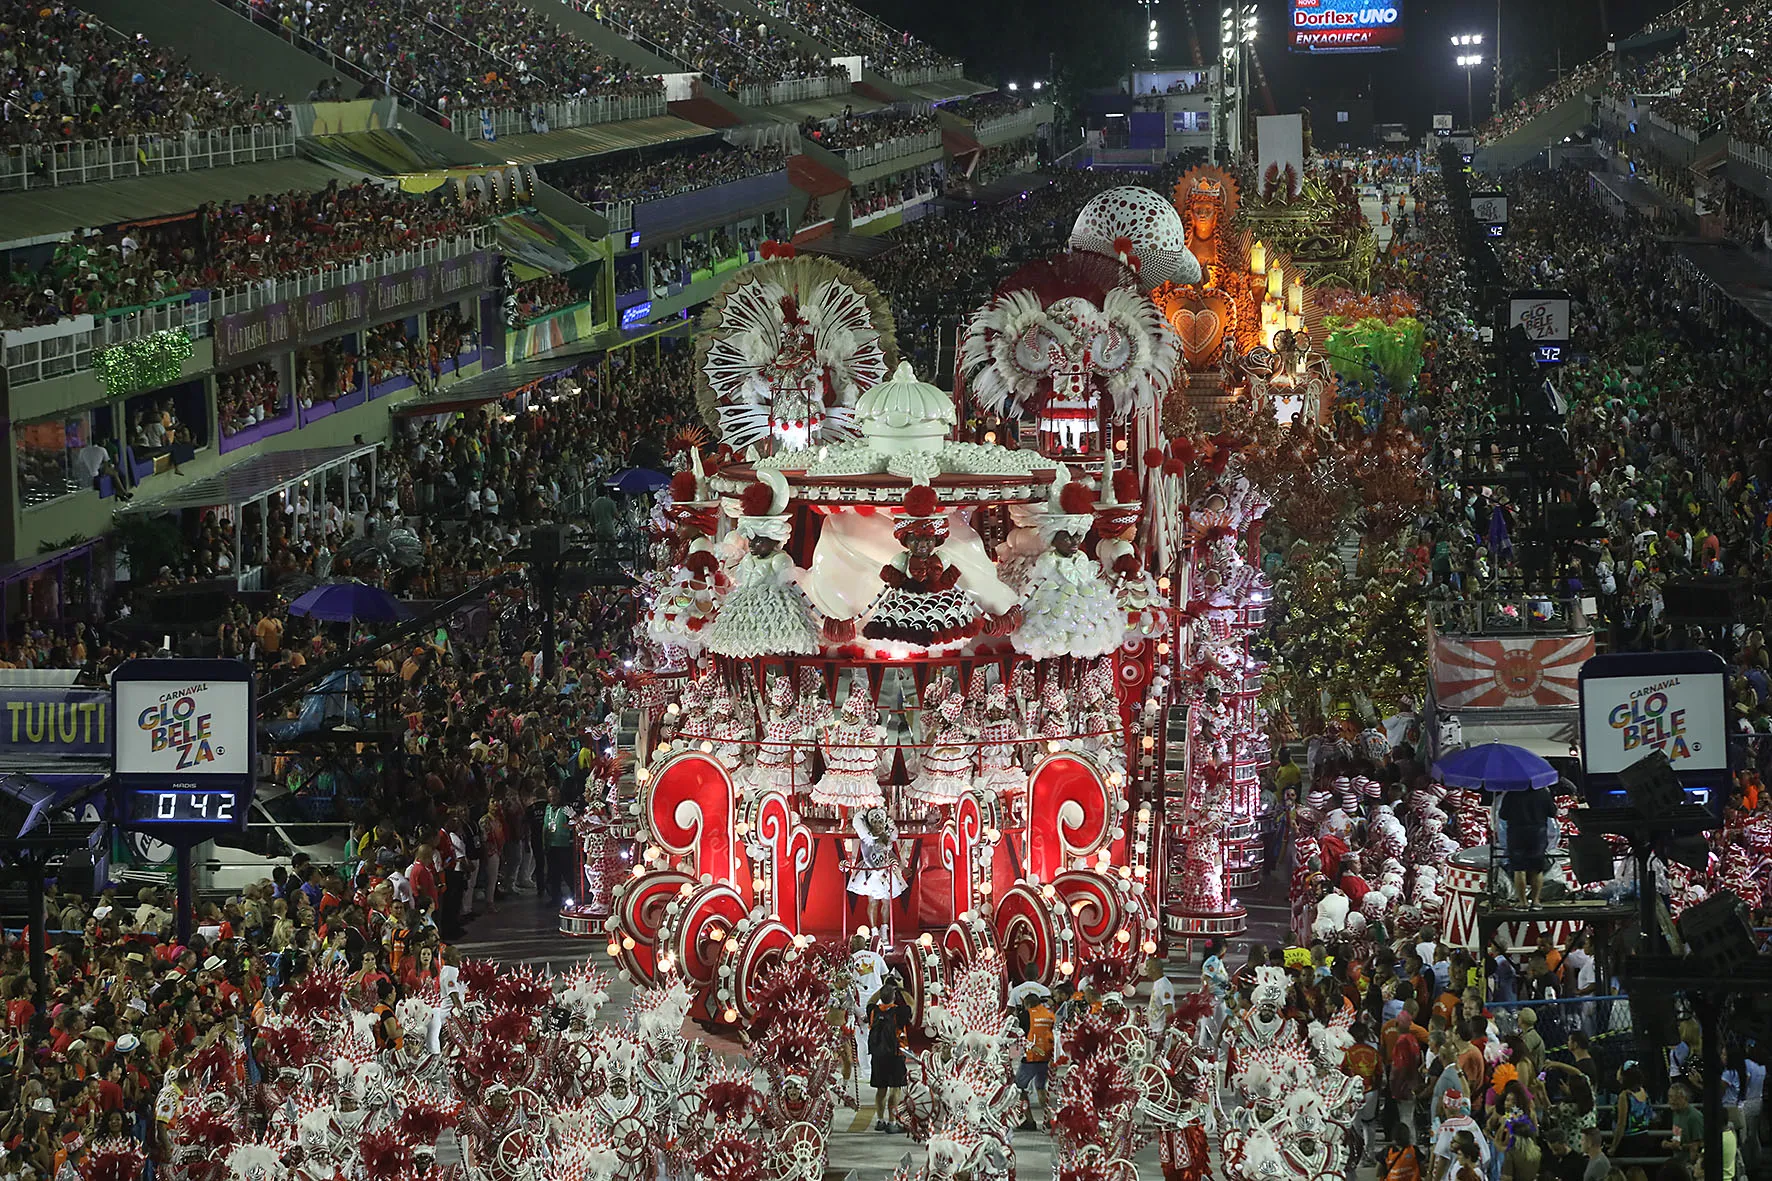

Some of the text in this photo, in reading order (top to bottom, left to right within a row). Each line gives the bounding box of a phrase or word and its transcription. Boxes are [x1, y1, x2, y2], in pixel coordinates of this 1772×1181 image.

[1295, 8, 1397, 25] Dorflex UNO
[1491, 226, 1503, 235] 42
[1520, 306, 1546, 321] GLO
[1537, 325, 1554, 339] ZA
[1541, 347, 1561, 361] 42
[159, 683, 208, 703] CARNAVAL
[1629, 678, 1681, 700] CARNAVAL
[138, 697, 196, 730] GLO
[1608, 692, 1668, 729] GLO
[7, 702, 105, 743] TUIUTI
[151, 713, 212, 752] BELE
[1623, 709, 1687, 751] BELE
[176, 739, 215, 770] ZA
